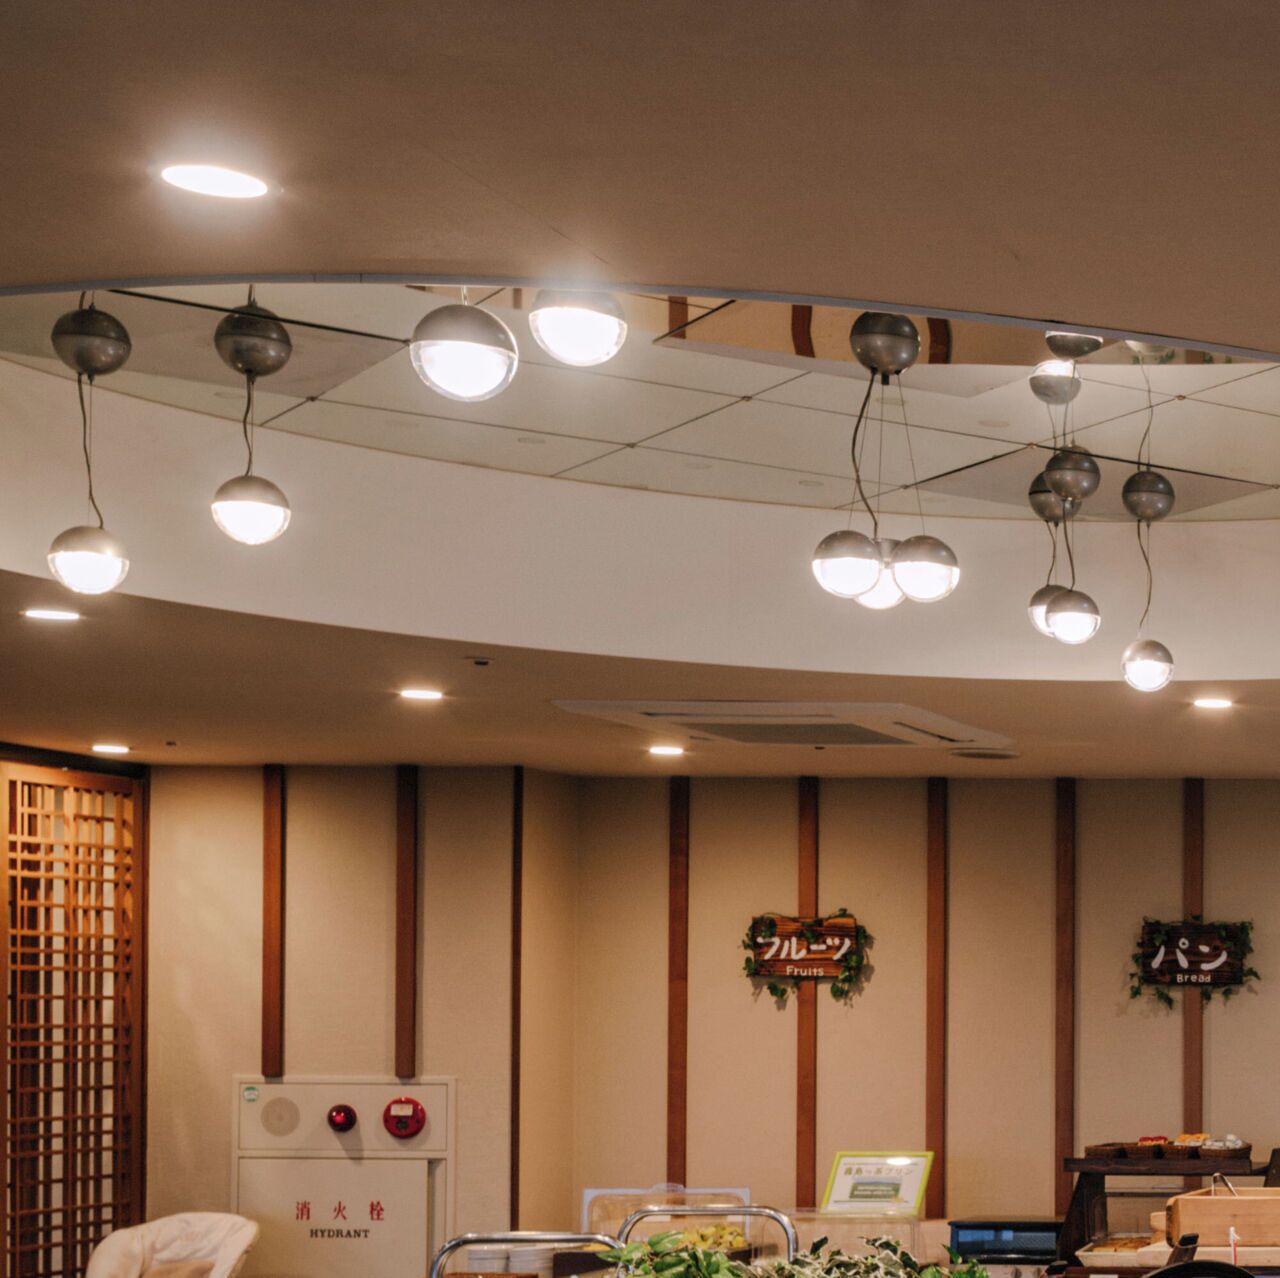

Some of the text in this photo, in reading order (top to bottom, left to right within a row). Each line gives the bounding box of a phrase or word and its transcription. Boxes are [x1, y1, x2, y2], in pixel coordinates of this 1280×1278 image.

[756, 936, 851, 960] フルーツ
[1151, 937, 1228, 971] パン
[786, 965, 824, 977] Fruits
[1176, 973, 1211, 983] Bread
[296, 1201, 384, 1221] 消火栓
[310, 1229, 370, 1239] HYDRANT
